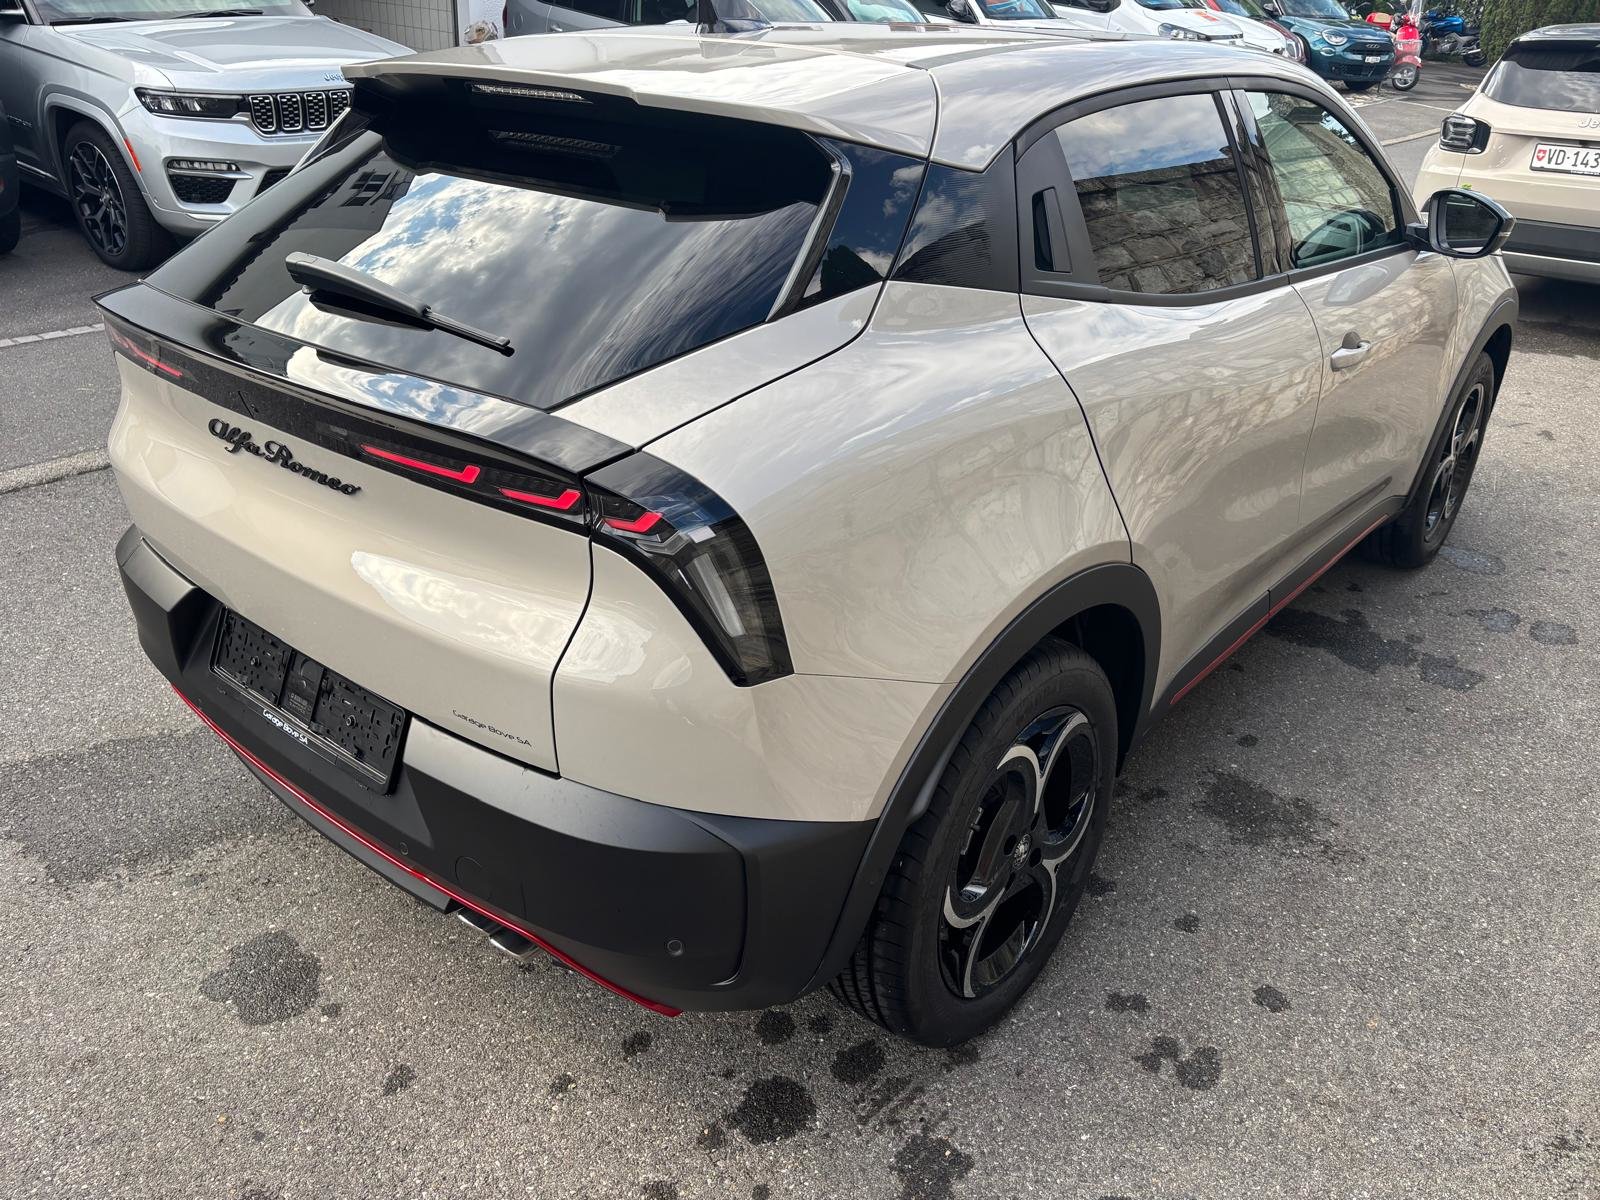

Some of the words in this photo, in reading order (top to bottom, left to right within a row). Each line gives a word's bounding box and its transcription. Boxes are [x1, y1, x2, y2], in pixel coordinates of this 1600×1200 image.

[1578, 118, 1600, 129] Je
[208, 418, 265, 455] Alfa
[264, 440, 362, 496] Romeo
[262, 709, 283, 727] Garage
[299, 733, 308, 745] SA
[452, 709, 487, 728] Garage
[488, 725, 515, 740] Bove
[516, 736, 532, 747] SA
